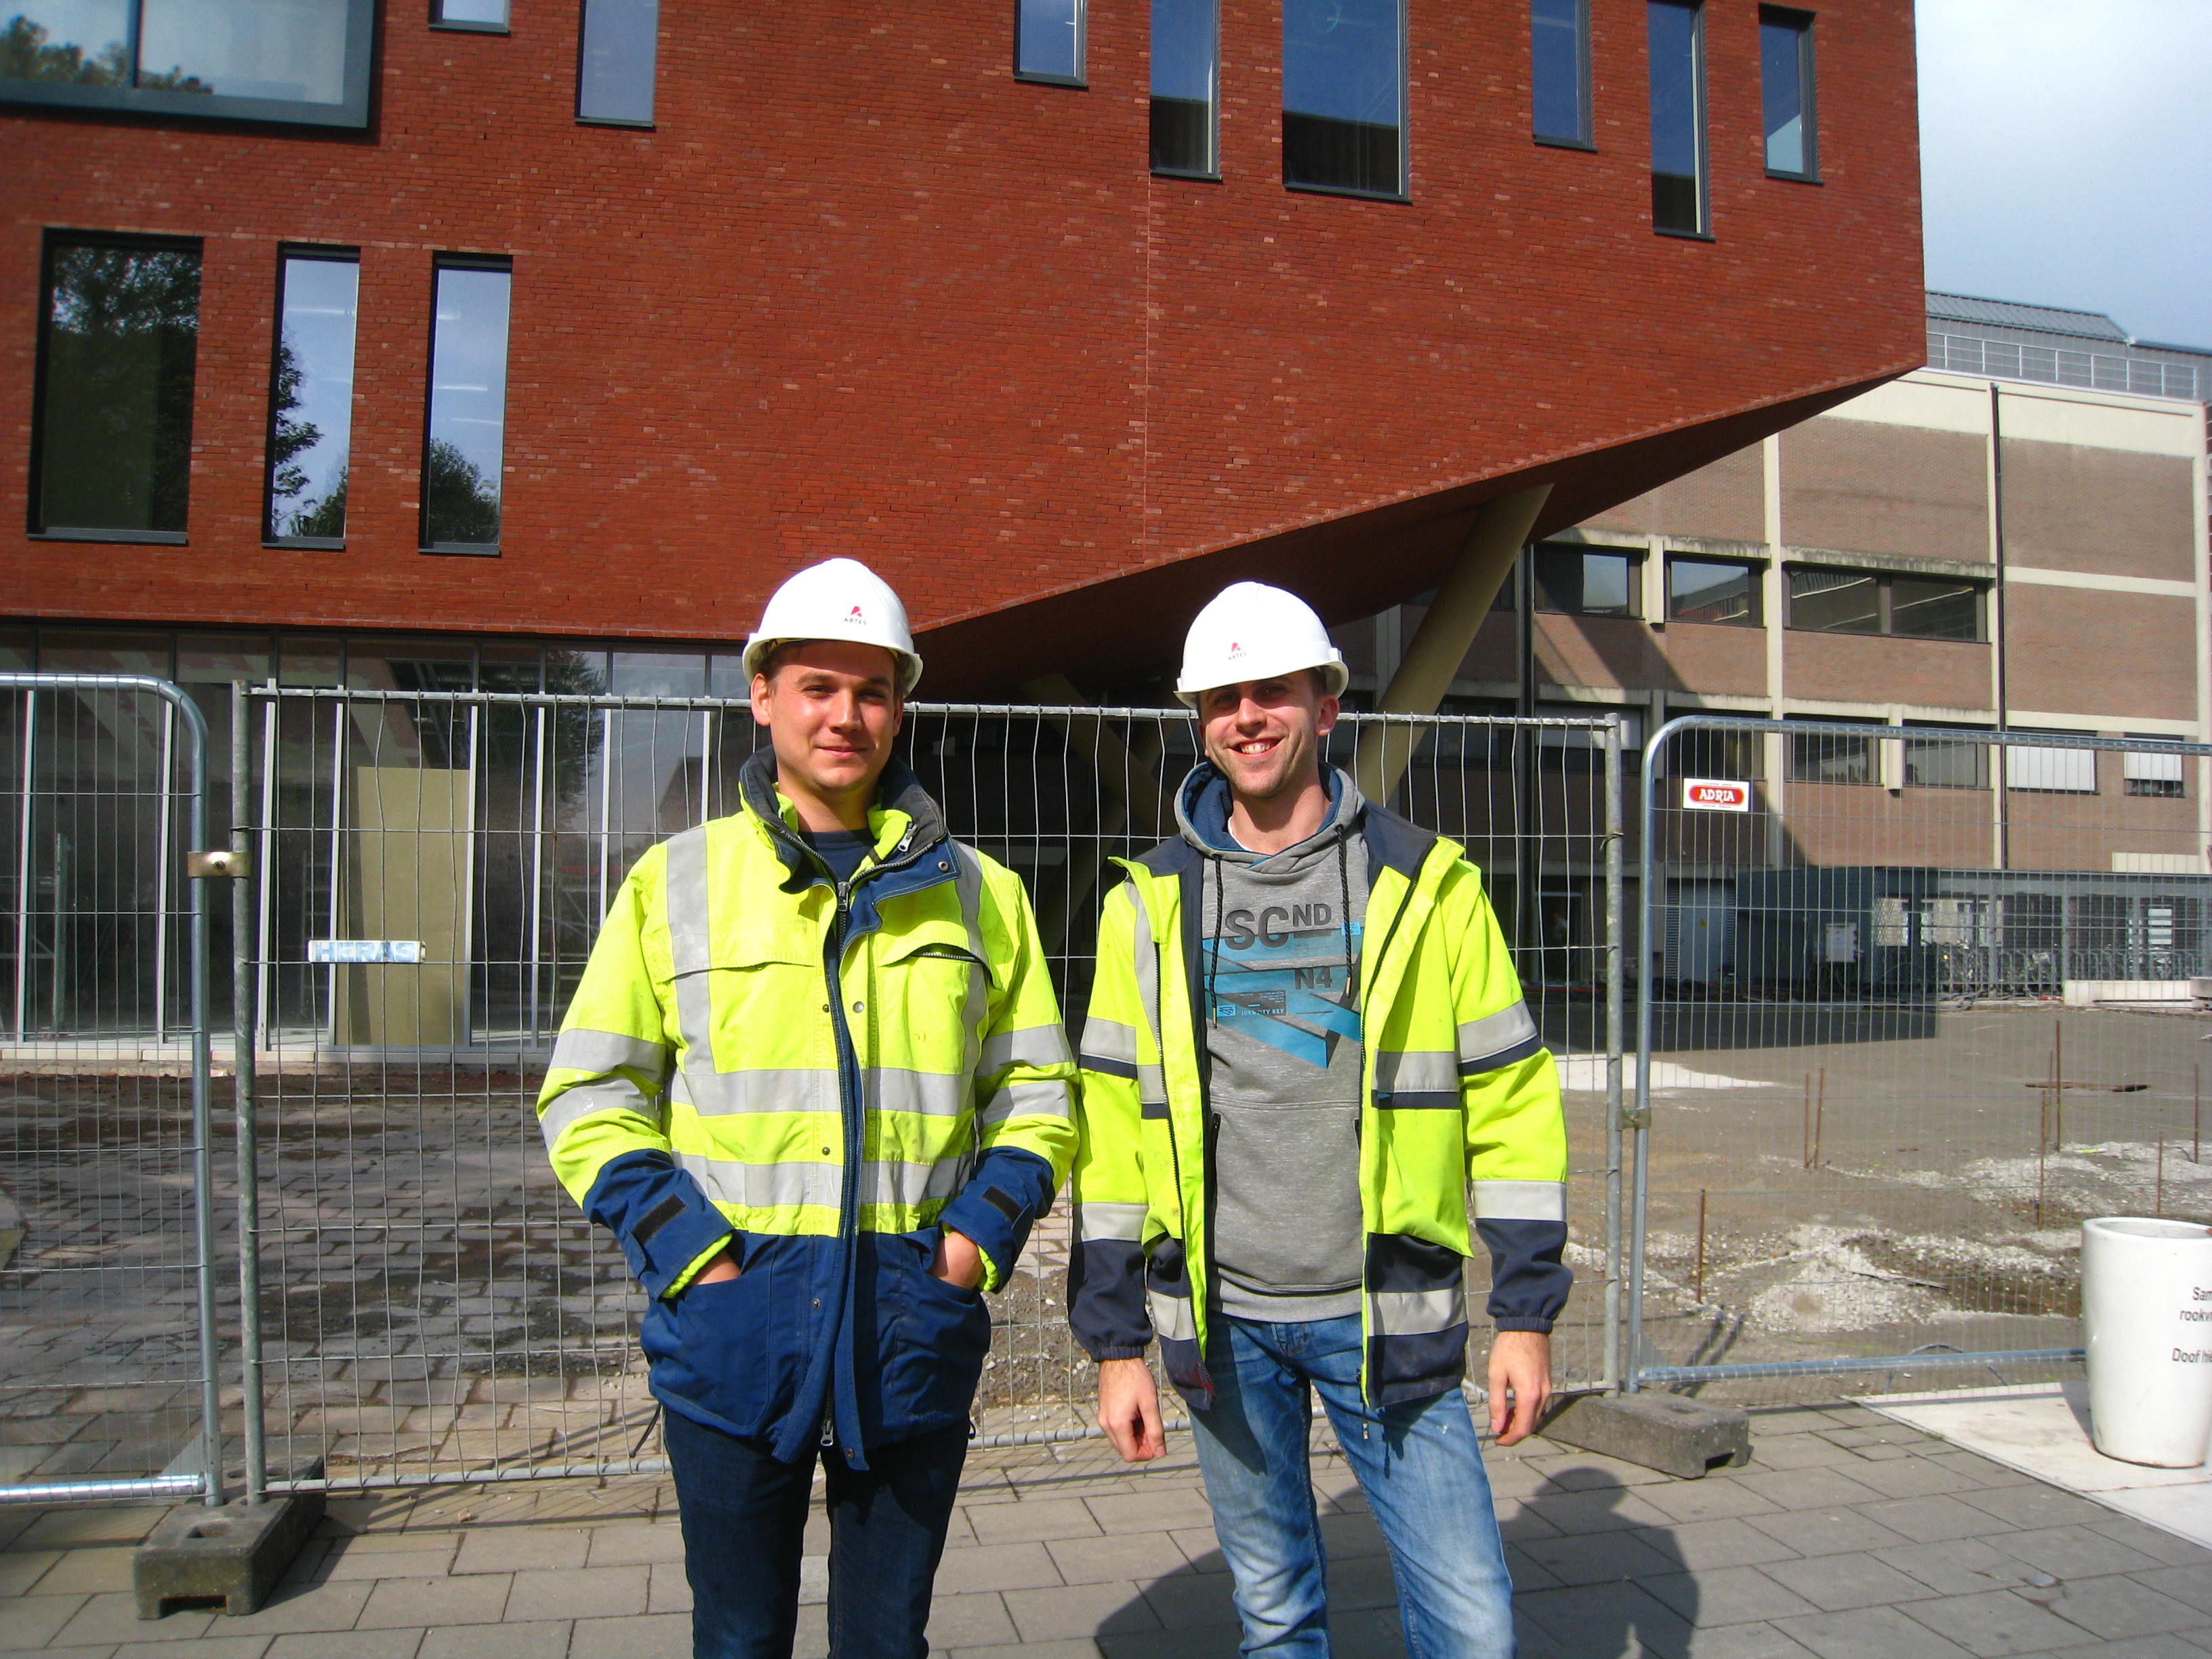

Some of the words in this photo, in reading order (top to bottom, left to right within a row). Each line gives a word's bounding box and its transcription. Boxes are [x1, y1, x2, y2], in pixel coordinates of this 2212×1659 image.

[844, 617, 866, 626] ARTES
[1699, 788, 1735, 802] ADRIA
[314, 941, 416, 962] HERAS
[1294, 967, 1332, 989] N4
[2171, 1347, 2200, 1363] Doof
